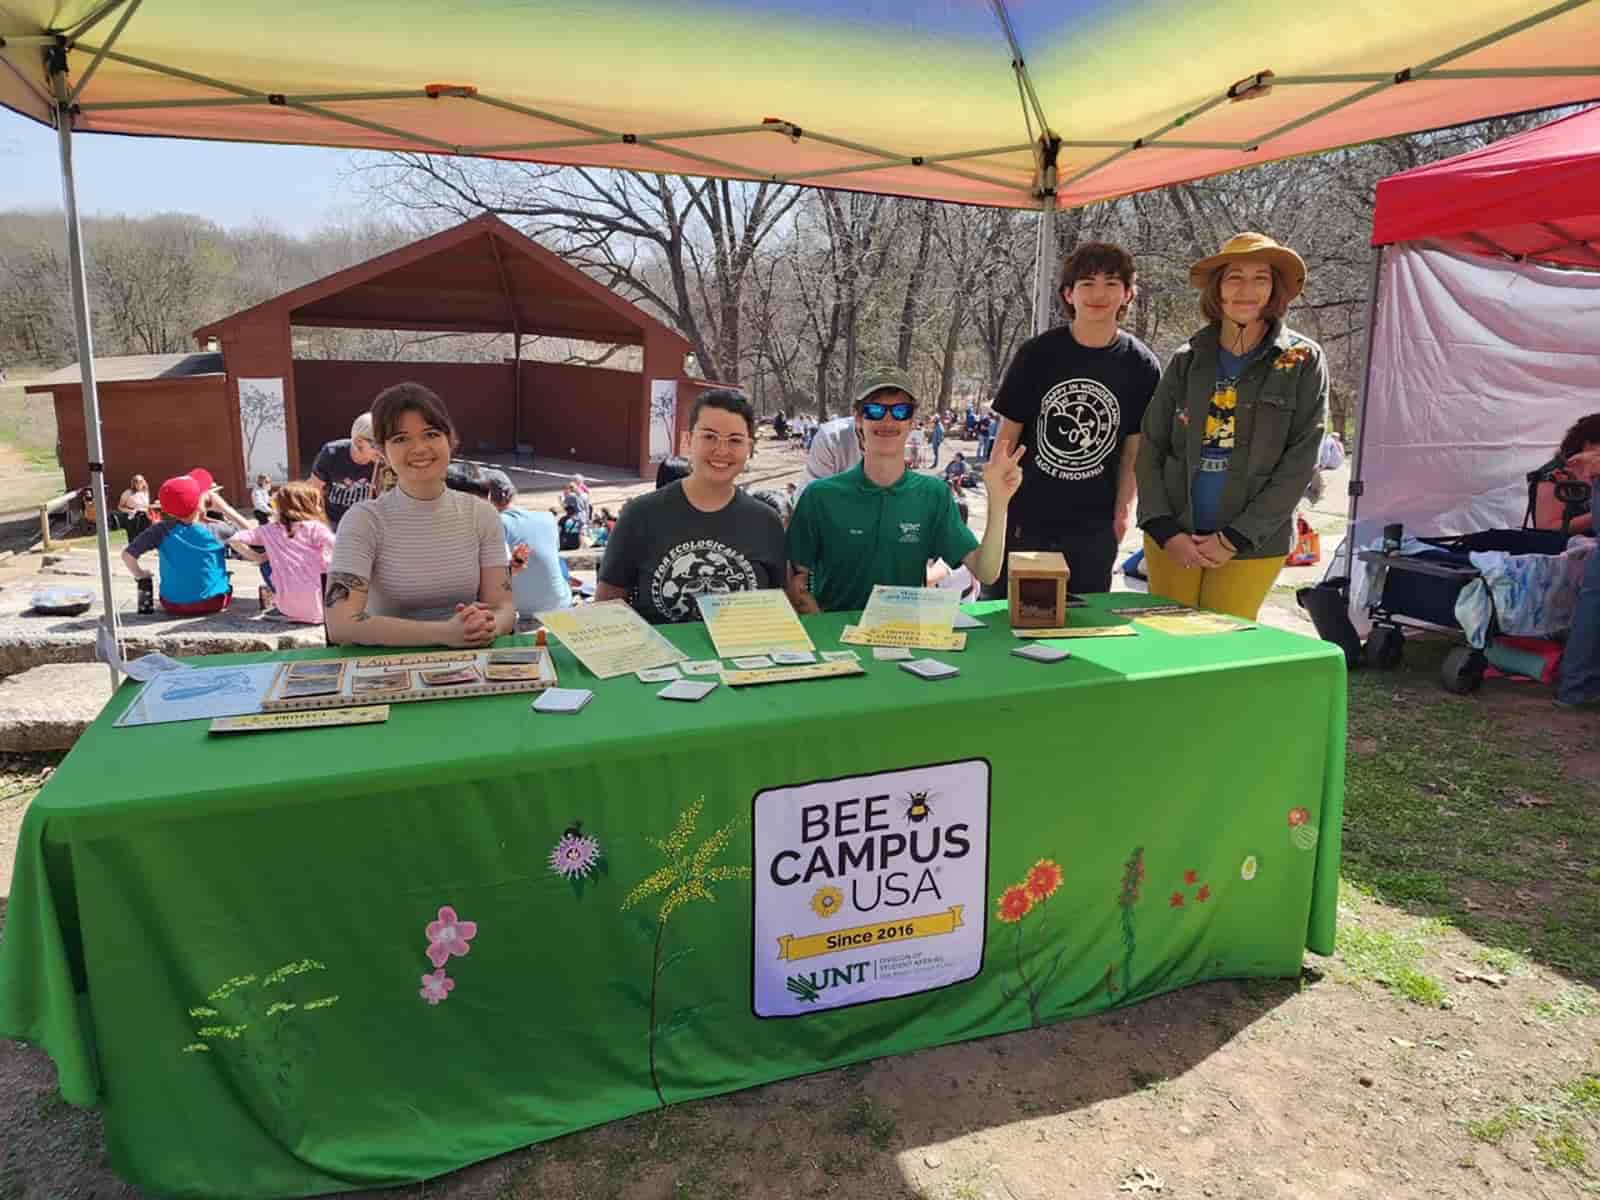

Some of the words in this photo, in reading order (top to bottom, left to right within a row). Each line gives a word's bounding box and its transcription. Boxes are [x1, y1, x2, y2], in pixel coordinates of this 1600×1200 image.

[669, 539, 737, 559] ECOLOGICAL
[801, 794, 890, 844] BEE
[770, 823, 970, 886] CAMPUS
[827, 931, 873, 950] Since
[877, 923, 914, 940] 2016
[810, 961, 870, 991] UNT
